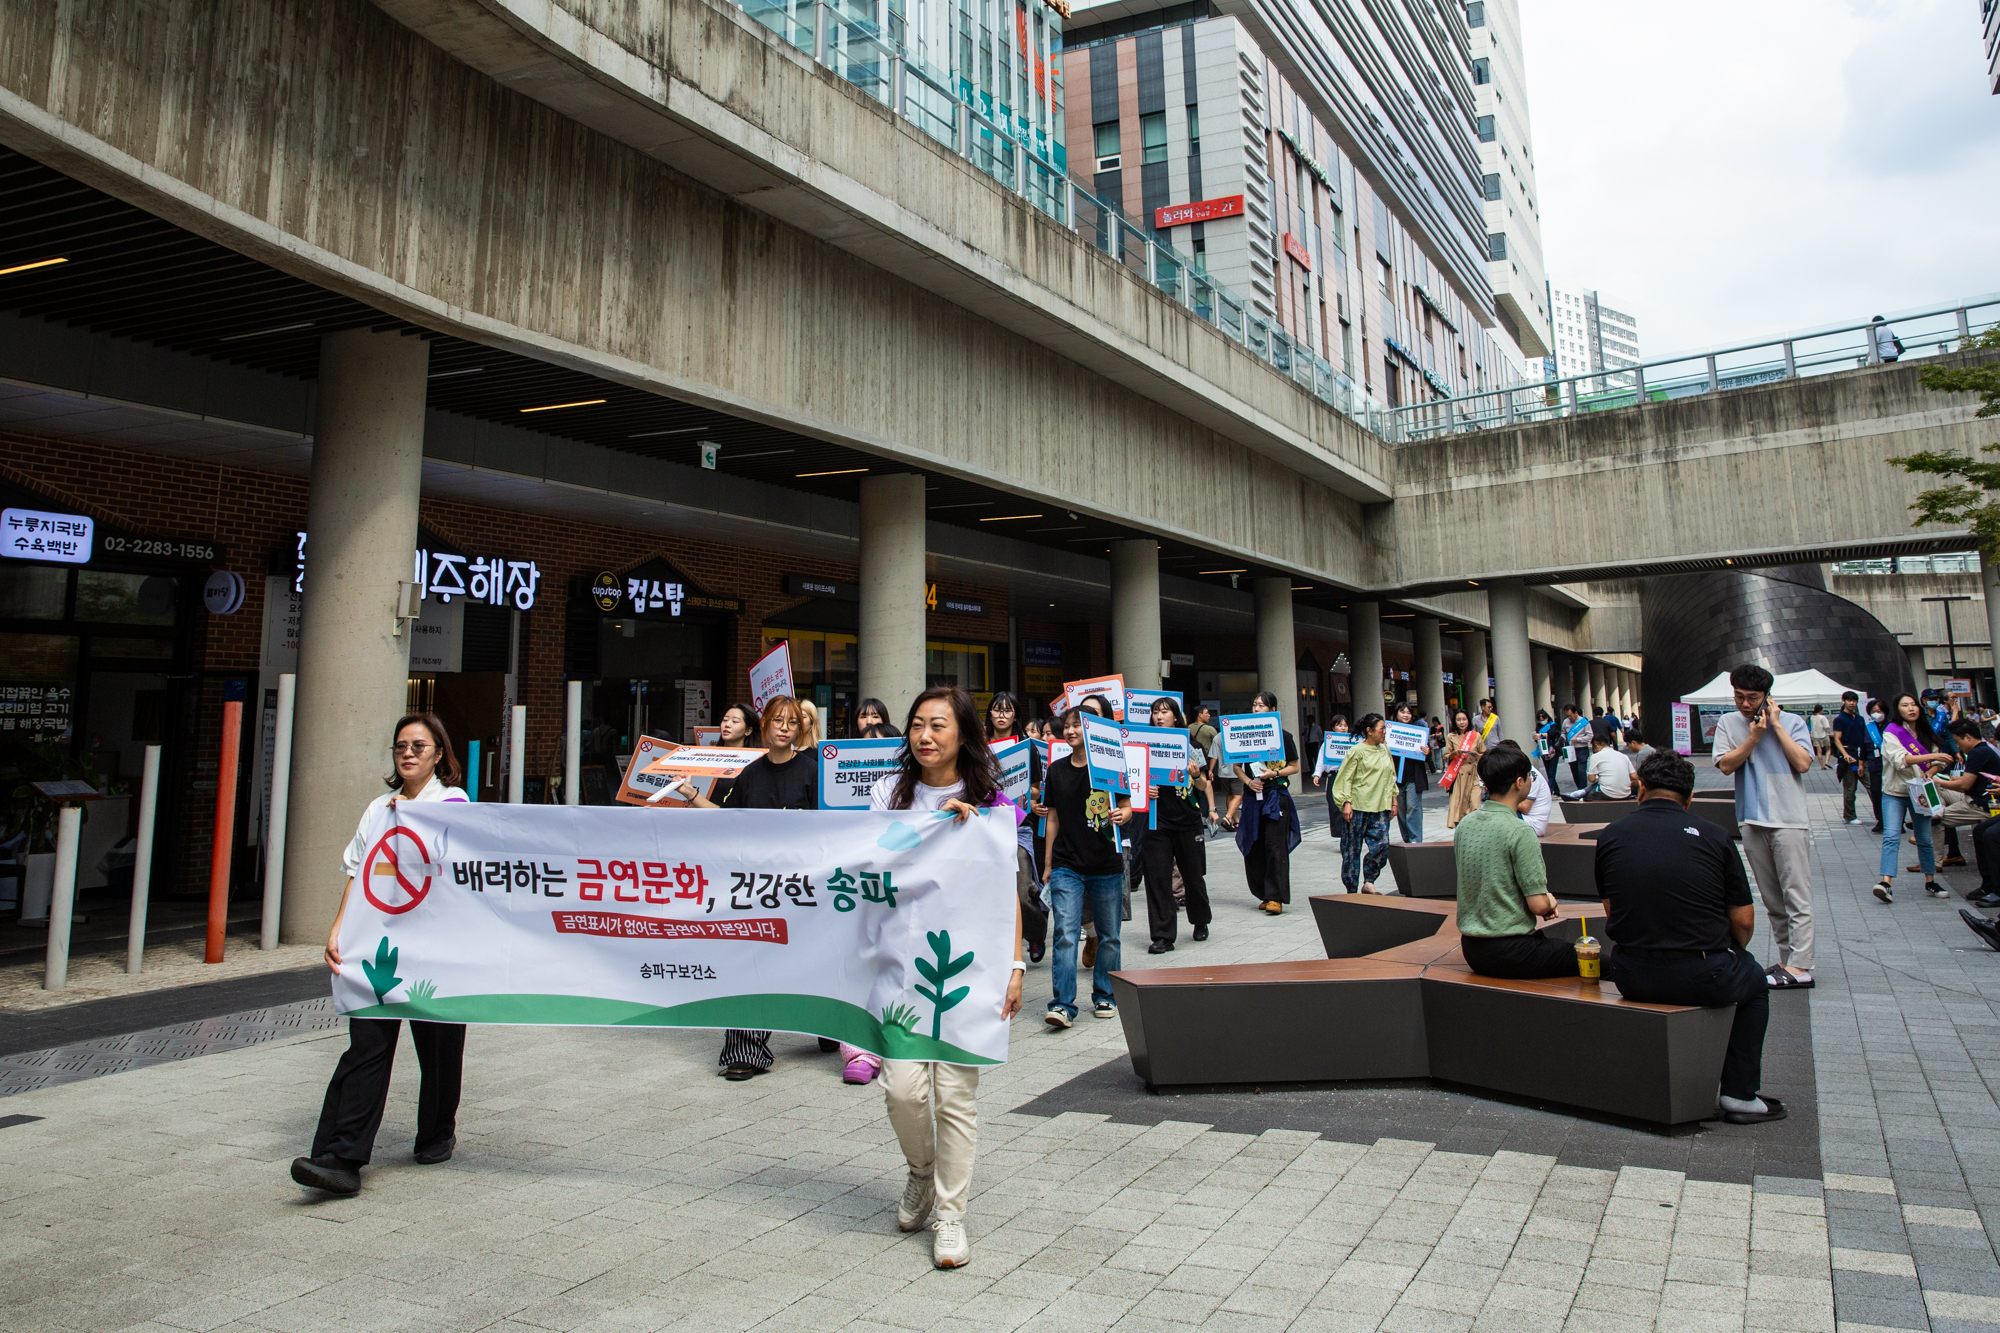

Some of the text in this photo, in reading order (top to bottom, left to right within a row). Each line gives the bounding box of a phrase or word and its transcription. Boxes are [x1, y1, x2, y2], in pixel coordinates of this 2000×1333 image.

[1162, 207, 1194, 224] 놀러와
[1221, 201, 1236, 213] 2F
[8, 515, 88, 537] 누룽지국밥
[14, 536, 79, 556] 수육백반
[105, 536, 214, 560] 02-2283-1556
[592, 586, 622, 599] cupstop
[627, 577, 685, 617] 컵스탑
[45, 703, 69, 714] 고기
[0, 717, 69, 730] 품 해장국밥
[838, 759, 861, 768] 건강한
[862, 758, 884, 767] 사회를
[1172, 751, 1186, 760] 반대
[452, 858, 899, 914] 배려하는 금연문화, 건강한 송파
[562, 914, 781, 940] 금연표시가 없어도 금연이 기본입니다.
[639, 962, 717, 980] 송파구보건소
